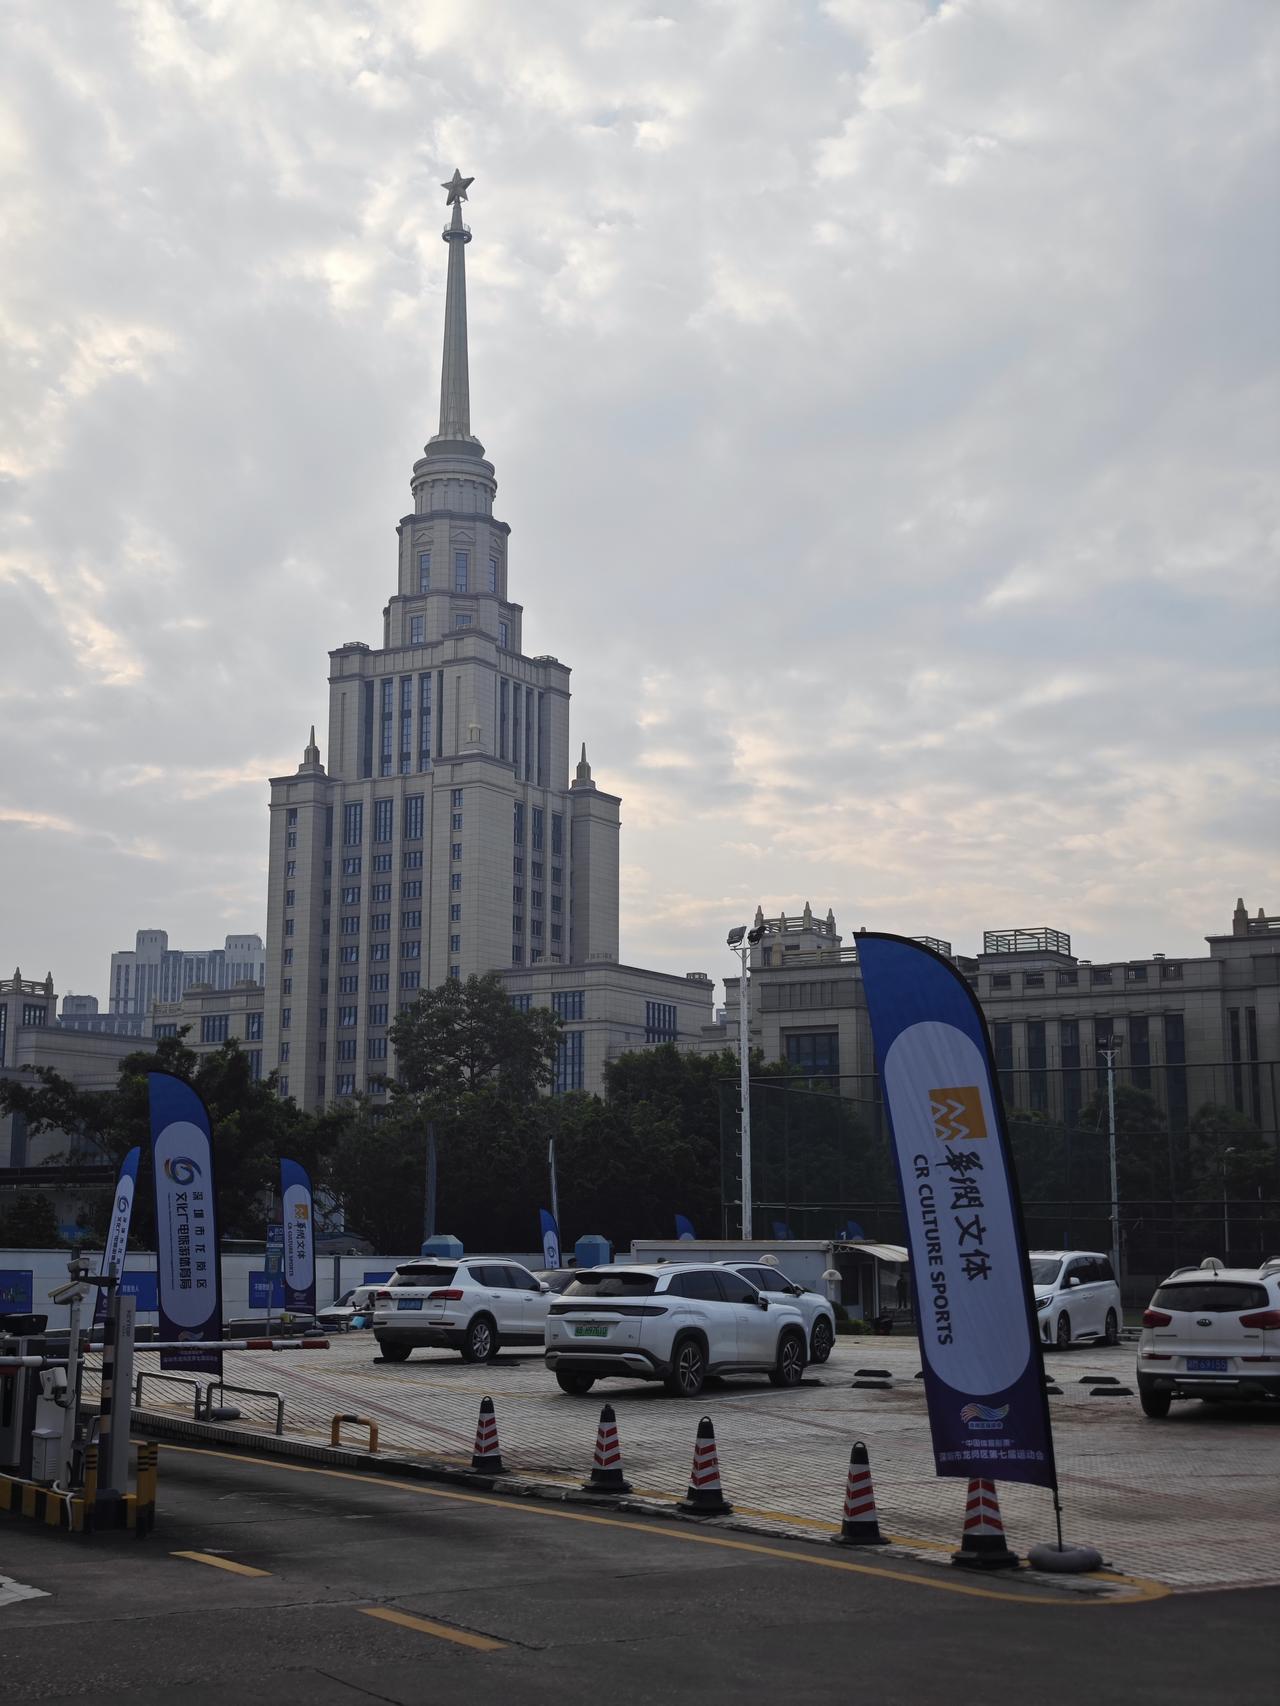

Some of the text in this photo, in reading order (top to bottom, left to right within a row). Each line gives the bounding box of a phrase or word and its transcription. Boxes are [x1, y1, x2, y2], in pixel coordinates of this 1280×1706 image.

[913, 1154, 953, 1346] CR CULTURE SPORTS
